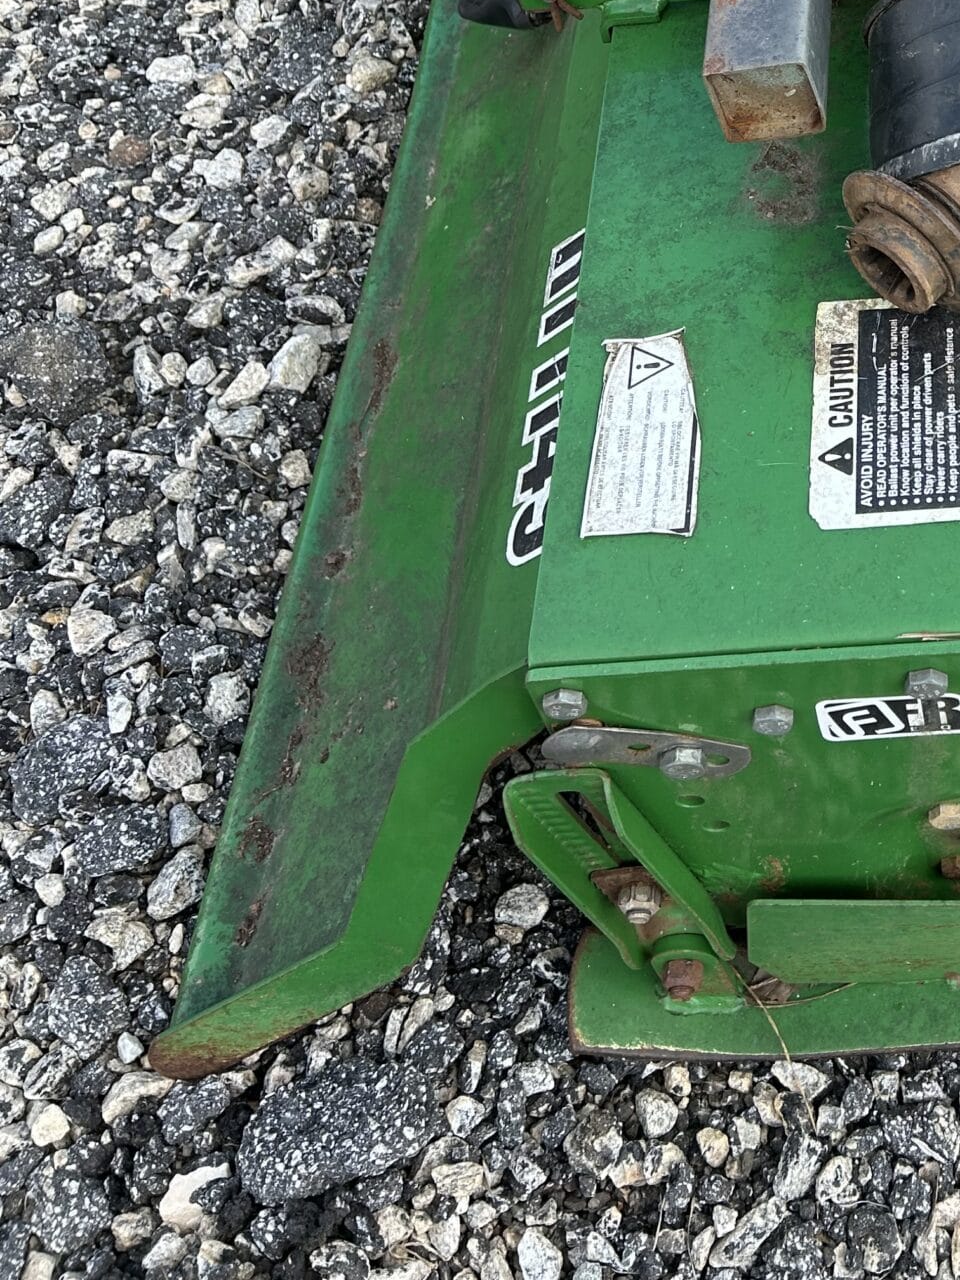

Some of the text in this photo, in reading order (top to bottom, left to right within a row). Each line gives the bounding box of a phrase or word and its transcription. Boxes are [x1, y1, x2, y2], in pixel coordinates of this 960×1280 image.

[889, 319, 898, 349] manual
[945, 328, 954, 363] distance
[828, 343, 854, 427] CAUTION
[890, 398, 900, 411] per
[900, 326, 910, 496] Know location and function of controls
[947, 394, 958, 413] pets
[877, 364, 886, 497] READ OPERATOR'S MANUAL
[889, 414, 898, 432] unit
[922, 353, 935, 494] Stay clear of power driven parts
[947, 414, 956, 433] and
[890, 434, 900, 462] power
[912, 386, 923, 495] Keep all shields in place
[935, 411, 947, 494] Never carry riders
[948, 435, 959, 466] people
[861, 414, 873, 507] AVOID INJURY
[888, 464, 898, 497] Ballast
[948, 469, 959, 493] Keep
